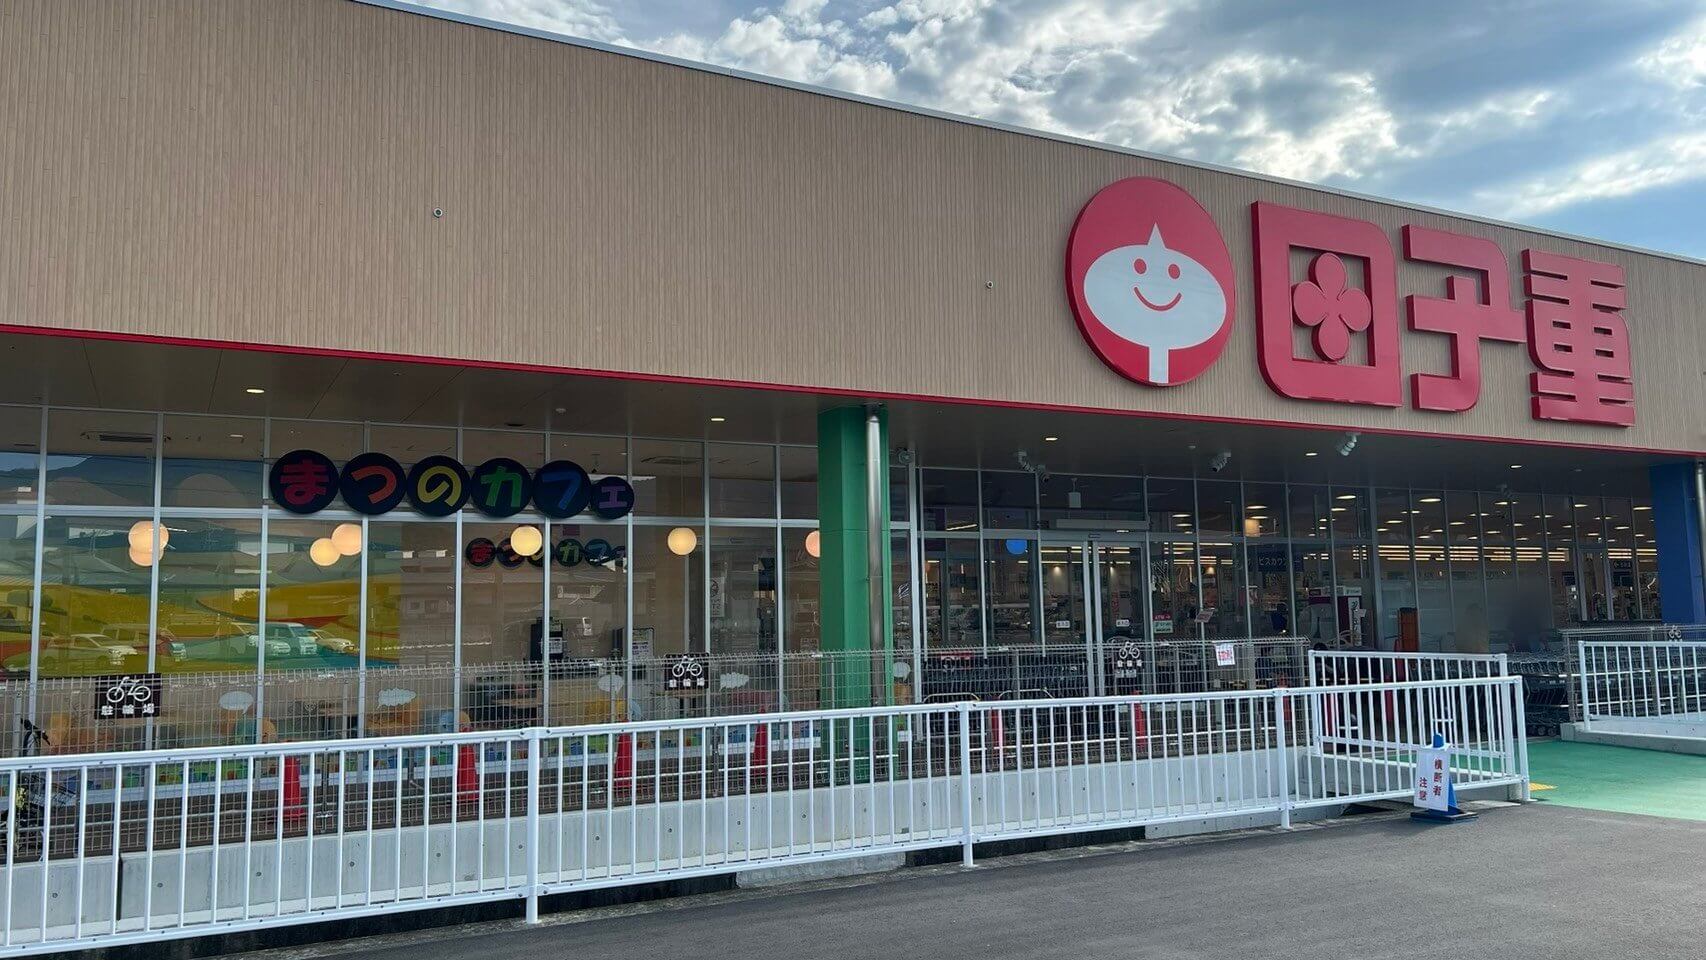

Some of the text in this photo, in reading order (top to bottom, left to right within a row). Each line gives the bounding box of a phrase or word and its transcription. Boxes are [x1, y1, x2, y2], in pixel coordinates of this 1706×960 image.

[279, 459, 630, 510] まつのカフェ
